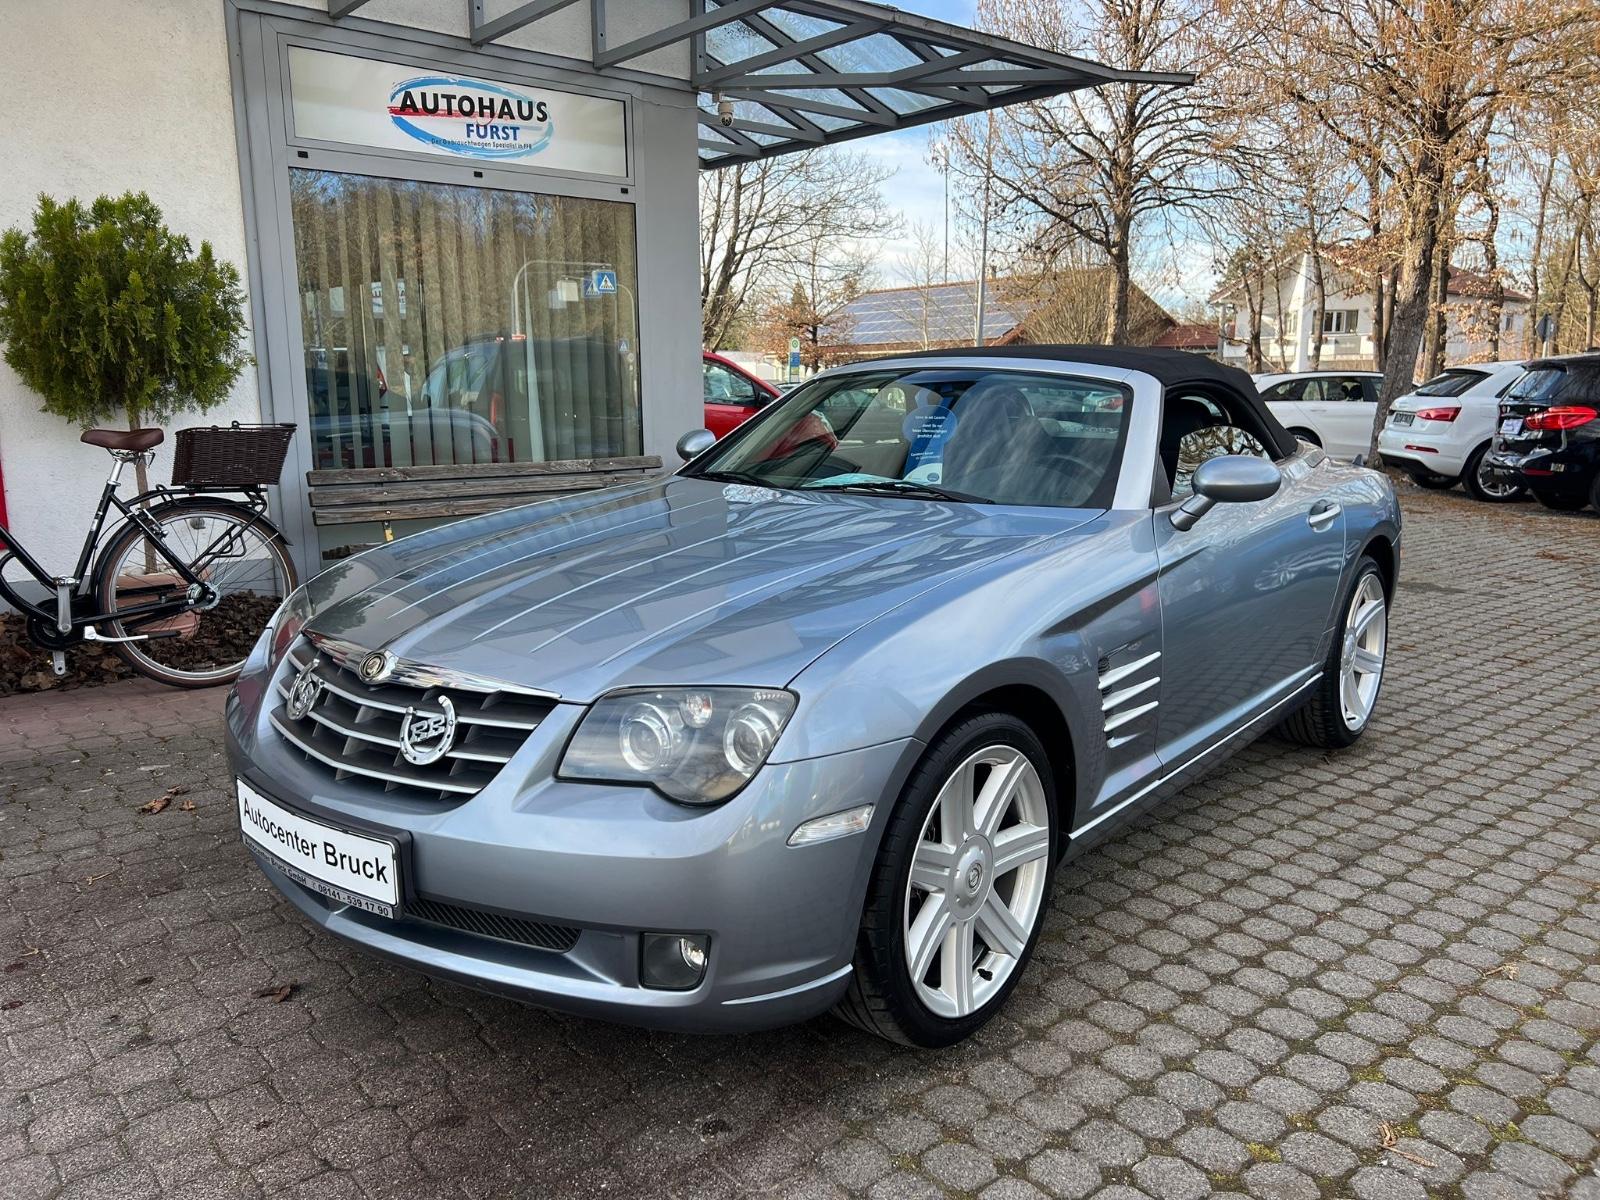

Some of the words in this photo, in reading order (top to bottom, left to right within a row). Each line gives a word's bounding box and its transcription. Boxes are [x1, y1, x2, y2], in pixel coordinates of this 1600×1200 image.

[400, 90, 548, 122] AUTOHAUS
[243, 797, 317, 860] Autocenter
[323, 841, 389, 884] Bruck
[287, 868, 307, 884] GmbH
[318, 884, 340, 900] 08141
[347, 895, 363, 908] 539
[364, 902, 375, 912] 17
[377, 906, 389, 917] 90
